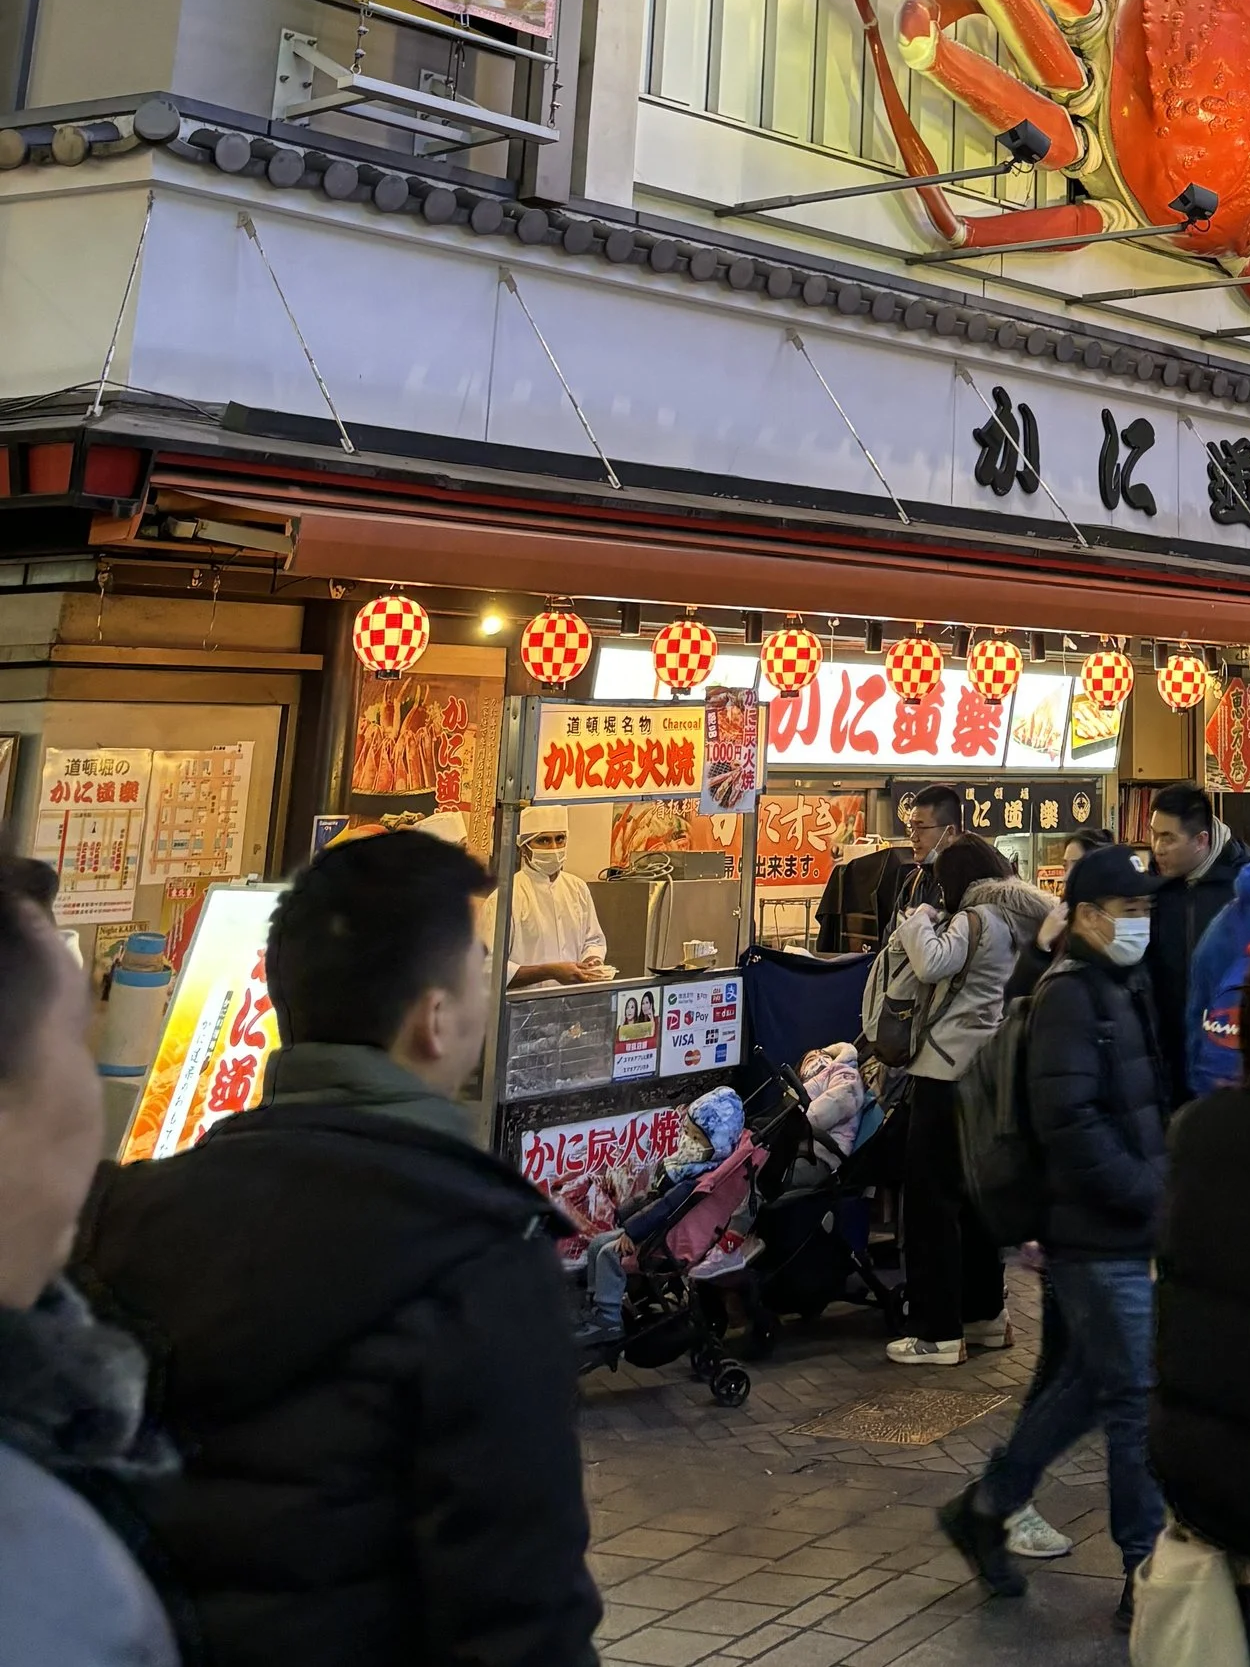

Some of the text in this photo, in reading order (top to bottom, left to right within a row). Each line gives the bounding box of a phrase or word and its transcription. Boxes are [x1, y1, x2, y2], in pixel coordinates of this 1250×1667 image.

[566, 715, 653, 737] 道頓堀名物
[434, 695, 469, 813] かに道
[543, 736, 697, 792] かに炭火焼
[64, 758, 130, 777] 道頓堀の
[653, 799, 700, 820] 看板料
[672, 1033, 694, 1048] VISA
[522, 1109, 683, 1181] かに炭火焼
